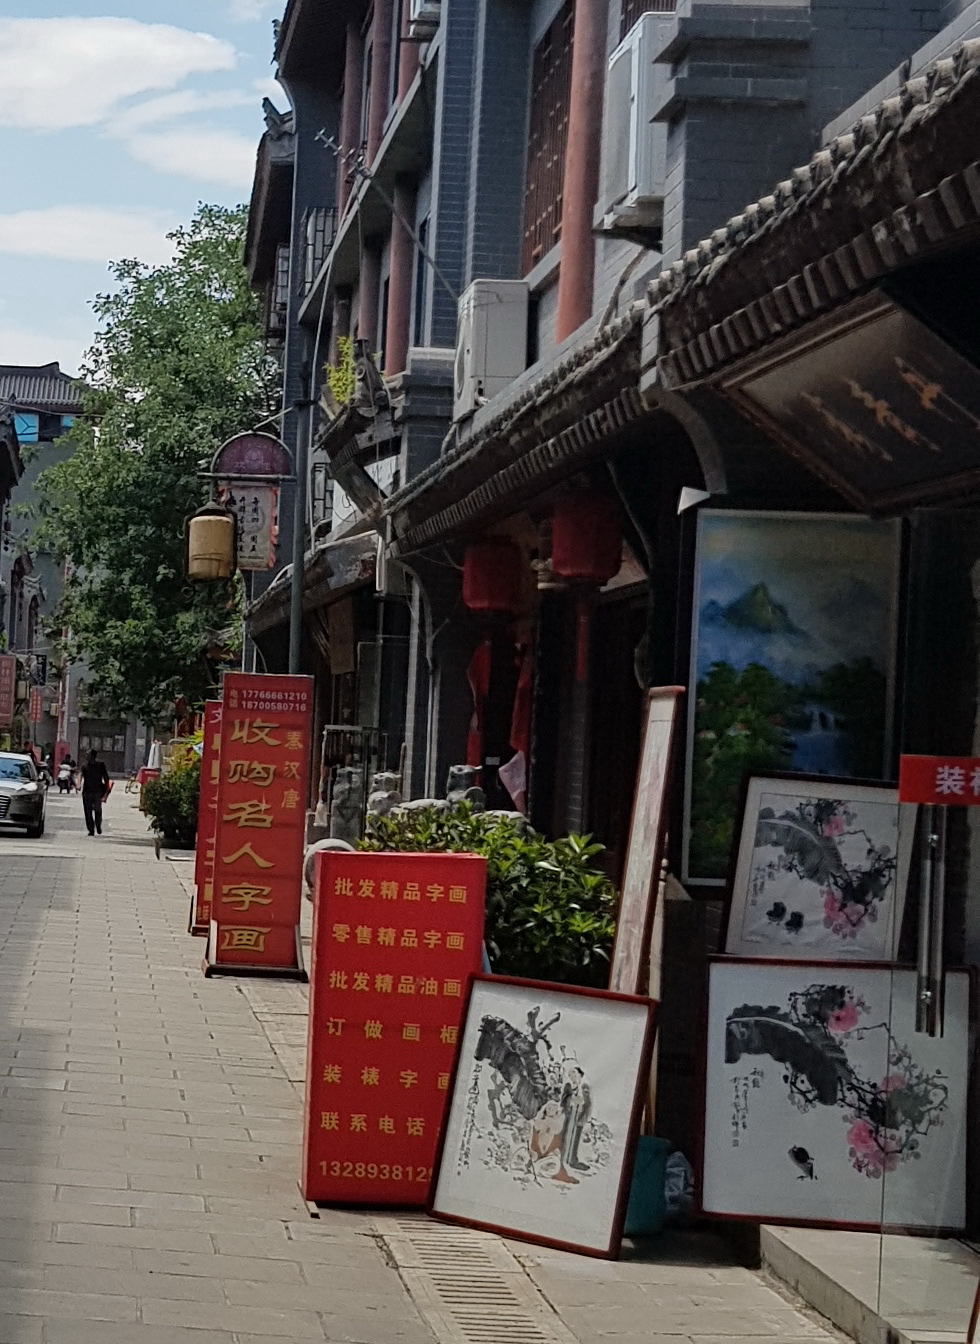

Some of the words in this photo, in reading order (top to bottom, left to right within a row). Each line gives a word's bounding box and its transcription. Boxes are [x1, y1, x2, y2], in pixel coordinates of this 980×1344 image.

[281, 730, 304, 808] 秦汉唐
[220, 717, 281, 952] 收购名人字画
[333, 876, 468, 904] 批发精品字画
[331, 923, 465, 950] 零售精品字画
[329, 970, 462, 997] 批发精品油画
